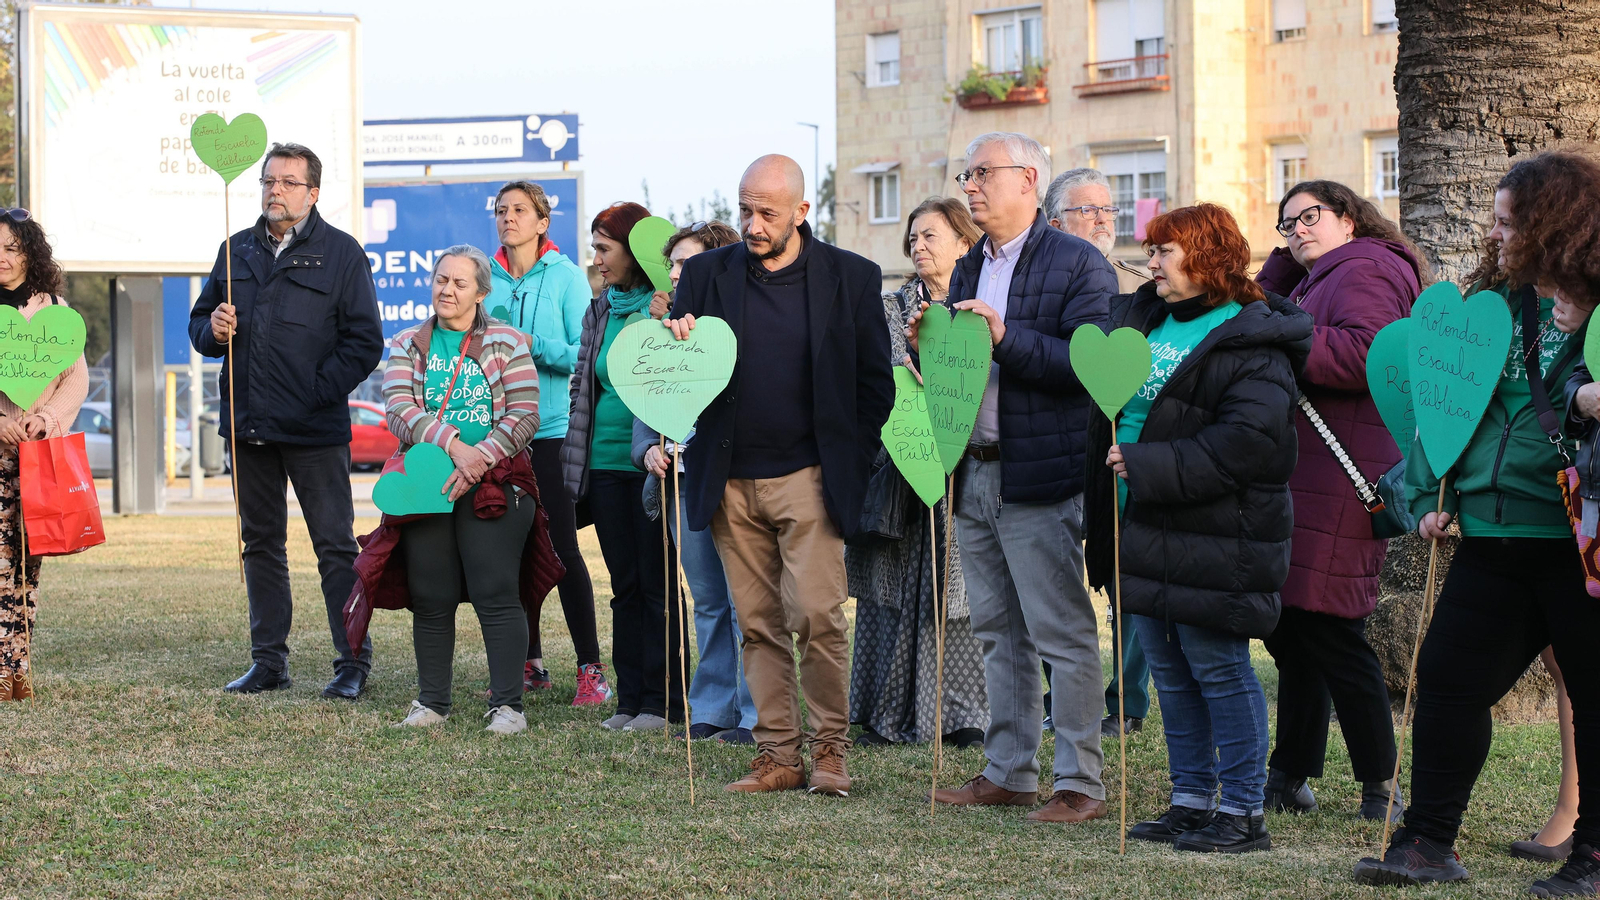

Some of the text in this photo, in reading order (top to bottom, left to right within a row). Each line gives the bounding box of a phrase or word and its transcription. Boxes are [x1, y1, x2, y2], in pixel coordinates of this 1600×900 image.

[161, 61, 245, 80] La vuelta
[174, 86, 231, 103] al cole
[193, 123, 225, 137] Rotonda
[160, 137, 192, 156] pap
[214, 135, 259, 152] Escuela
[456, 135, 466, 146] A
[159, 155, 179, 174] de
[0, 319, 74, 345] otonda:
[0, 344, 63, 364] scuela
[427, 358, 455, 375] UELA
[631, 354, 694, 375] Escuela
[1417, 346, 1482, 386] Escuela
[929, 373, 979, 405] Escuela
[1415, 380, 1478, 421] Pública
[892, 419, 934, 437] Escu
[932, 403, 971, 434] Pública
[895, 441, 942, 463] Públ
